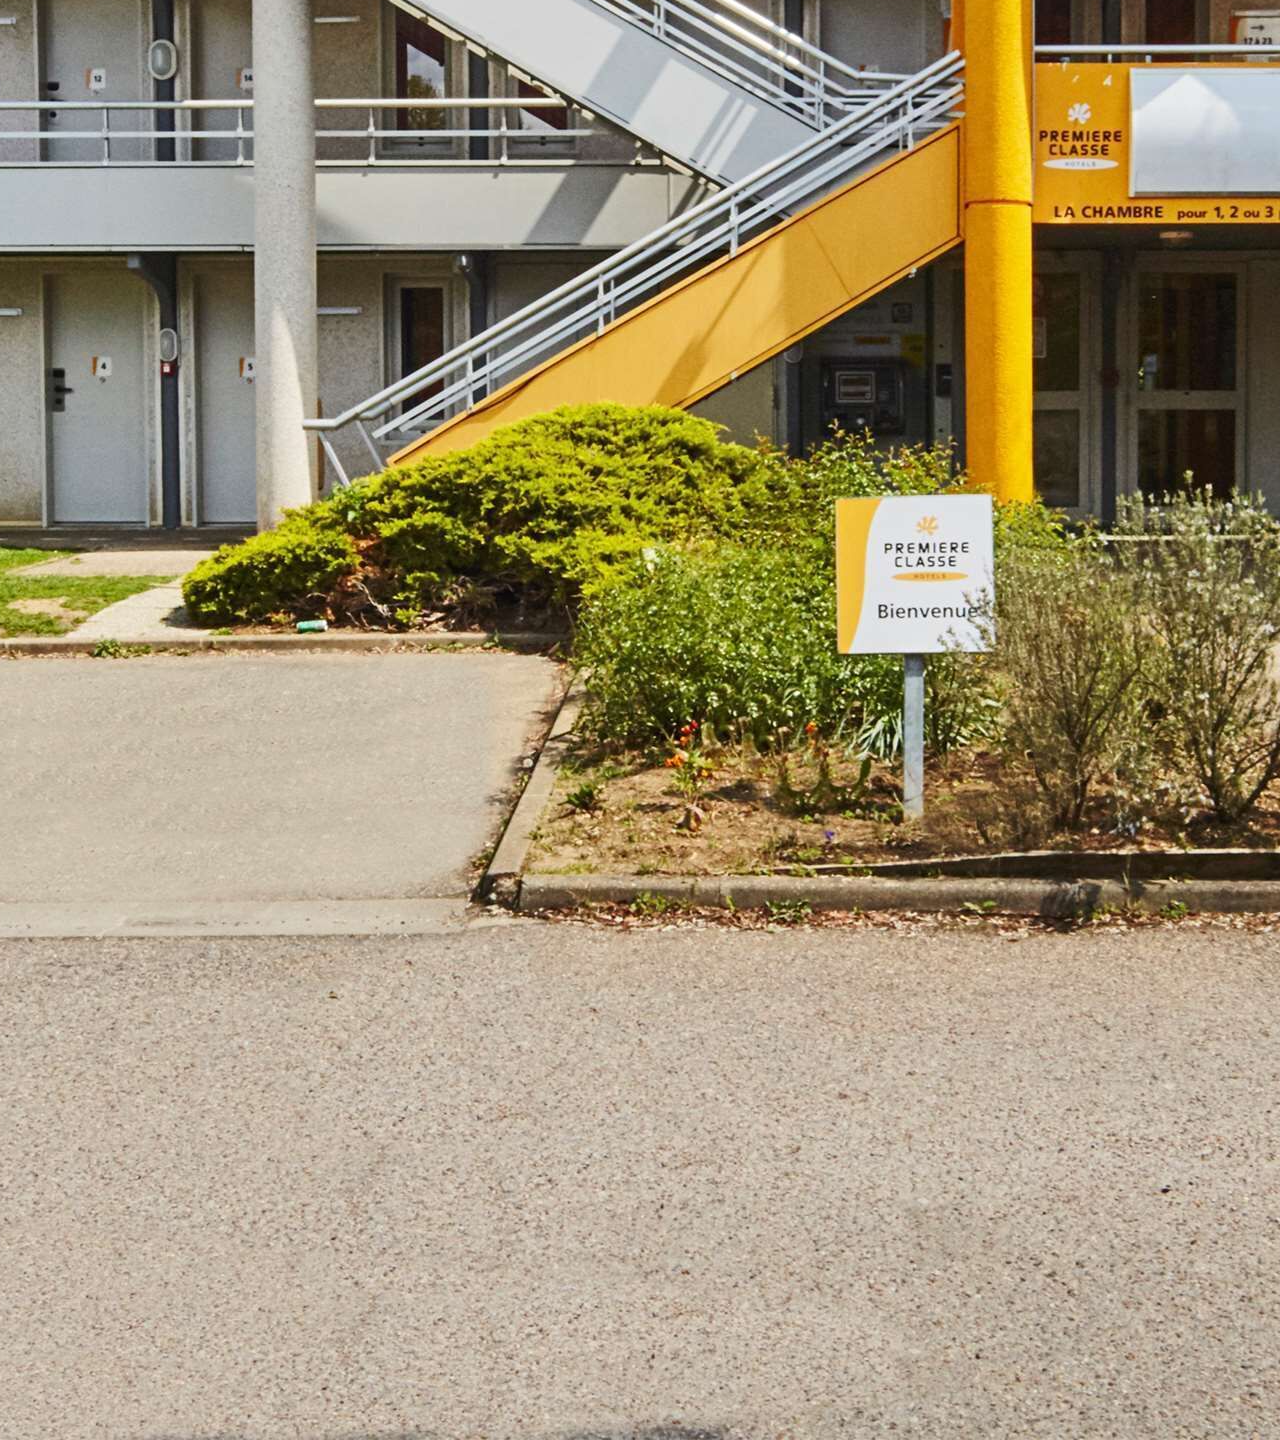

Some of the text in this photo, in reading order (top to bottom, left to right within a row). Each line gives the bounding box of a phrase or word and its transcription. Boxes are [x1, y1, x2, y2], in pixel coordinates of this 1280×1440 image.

[1039, 130, 1122, 143] PREMIERE
[1048, 144, 1110, 156] CLASSE
[1054, 206, 1075, 218] LA
[1082, 205, 1163, 218] CHAMBRE
[1177, 209, 1207, 221] pour
[1229, 206, 1239, 218] 2
[1244, 209, 1259, 218] ou
[1265, 206, 1274, 218] 3
[884, 542, 970, 554] PREMIERE
[894, 556, 957, 567] CLASSE
[878, 604, 978, 619] Bienvenue
